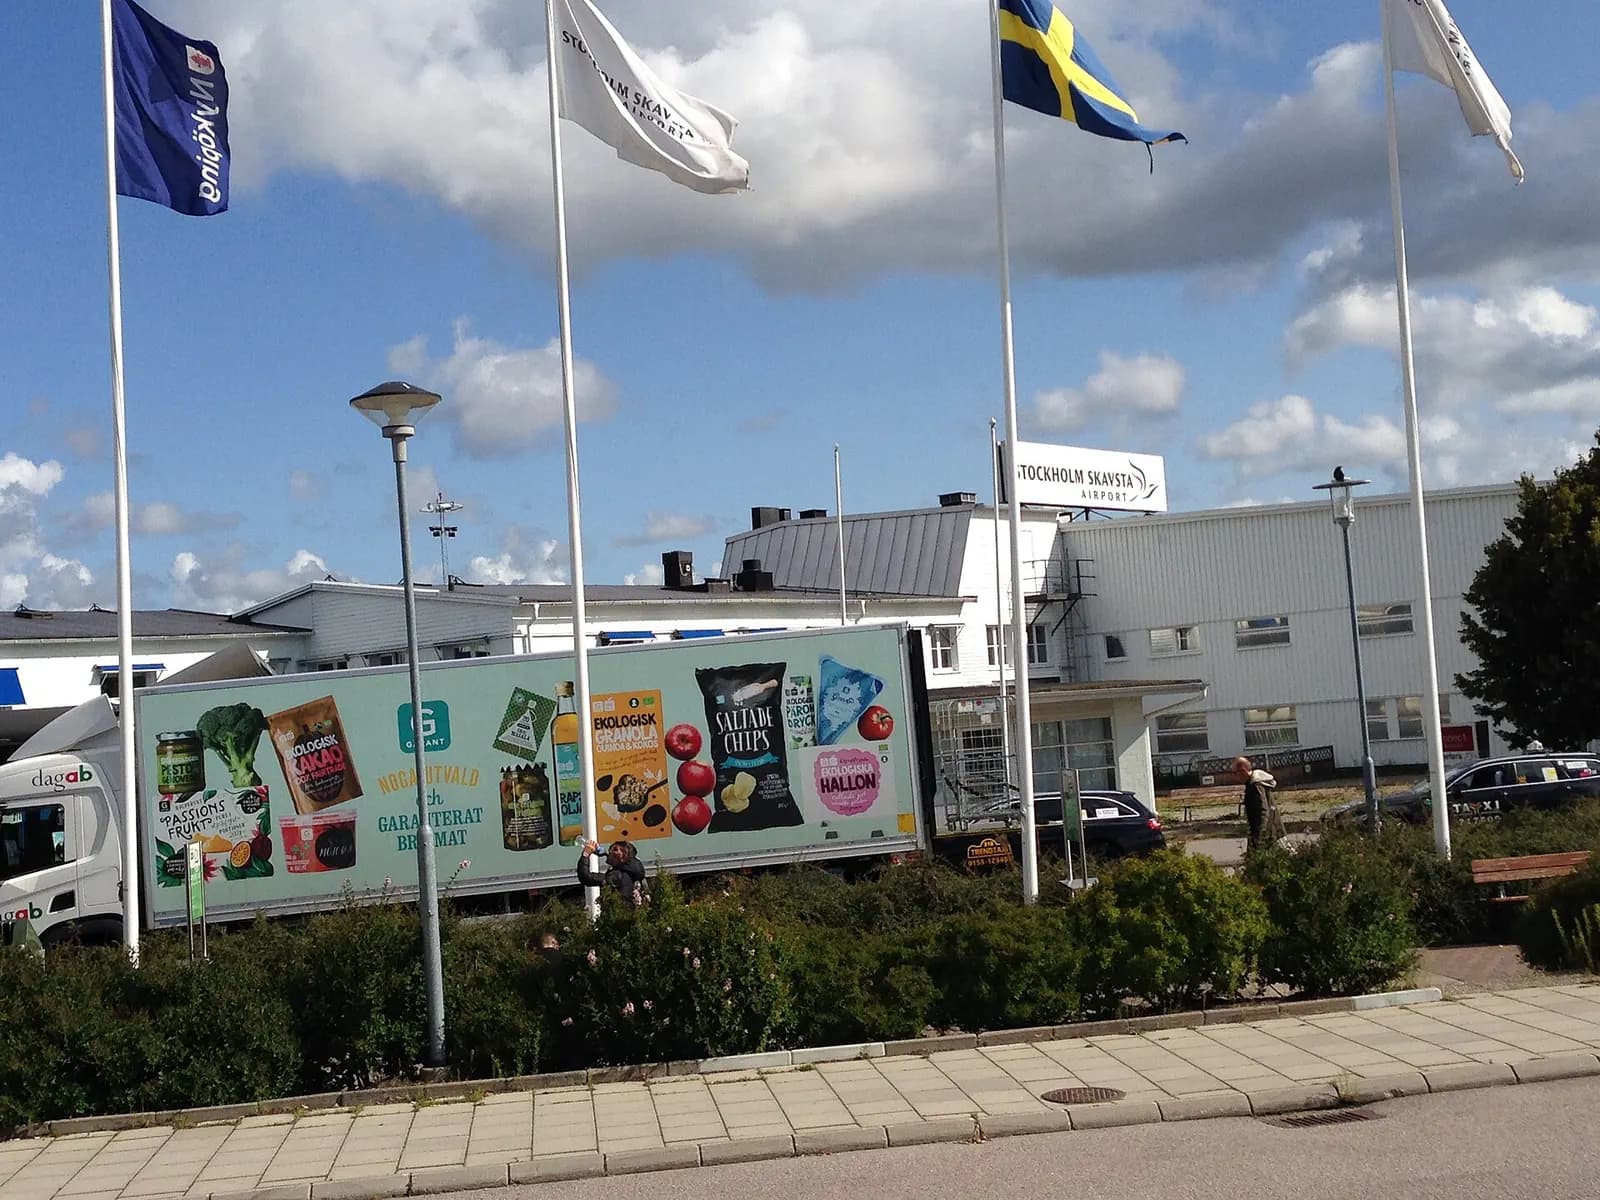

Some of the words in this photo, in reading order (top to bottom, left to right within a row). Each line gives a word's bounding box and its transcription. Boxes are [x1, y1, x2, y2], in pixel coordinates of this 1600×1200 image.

[1088, 470, 1134, 489] SKAVSTA
[1081, 489, 1127, 502] AIRPORT
[594, 712, 657, 730] EKOLOGISK
[715, 706, 774, 735] SALTADE
[405, 738, 445, 749] GANT
[595, 725, 658, 745] GRANOLA
[724, 729, 770, 754] CHIPS
[161, 763, 193, 776] PESTO
[291, 745, 344, 775] KAKAO
[32, 764, 93, 793] dagab
[820, 773, 876, 793] HALLON
[416, 788, 445, 806] ch
[1452, 800, 1500, 813] TAXI
[160, 799, 226, 828] PASSIONS
[378, 807, 483, 832] GARATERAT
[168, 817, 213, 840] FRUKT
[435, 829, 468, 848] MAT
